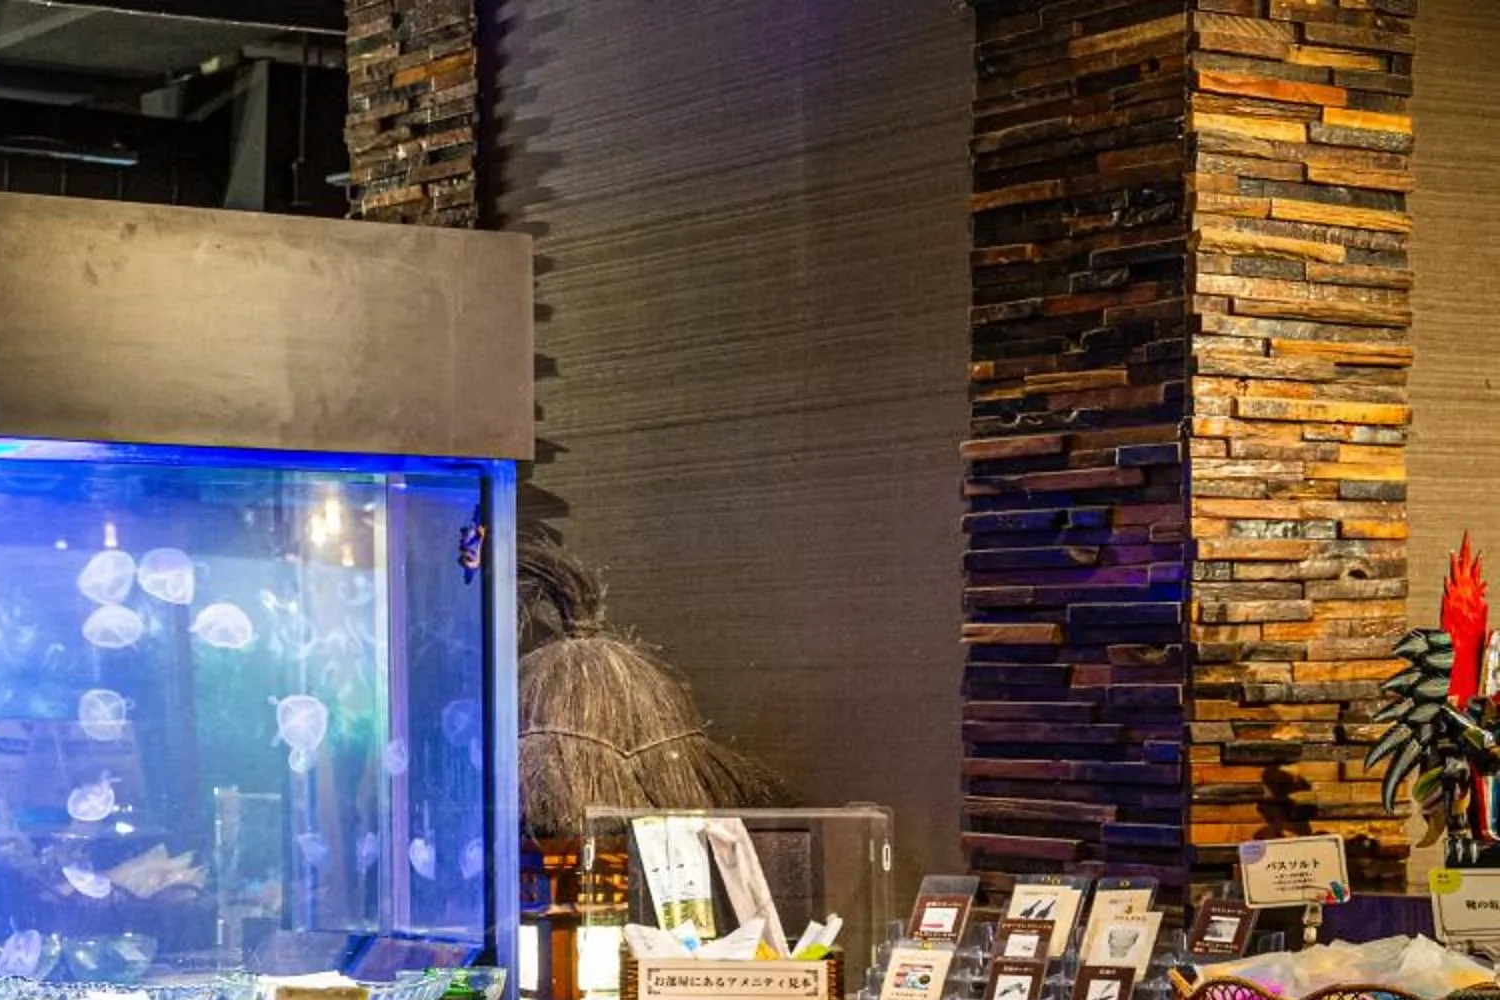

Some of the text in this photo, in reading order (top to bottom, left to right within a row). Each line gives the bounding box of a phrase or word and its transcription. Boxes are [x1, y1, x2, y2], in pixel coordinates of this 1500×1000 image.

[654, 975, 812, 988] お部屋にあるアメニティ見本
